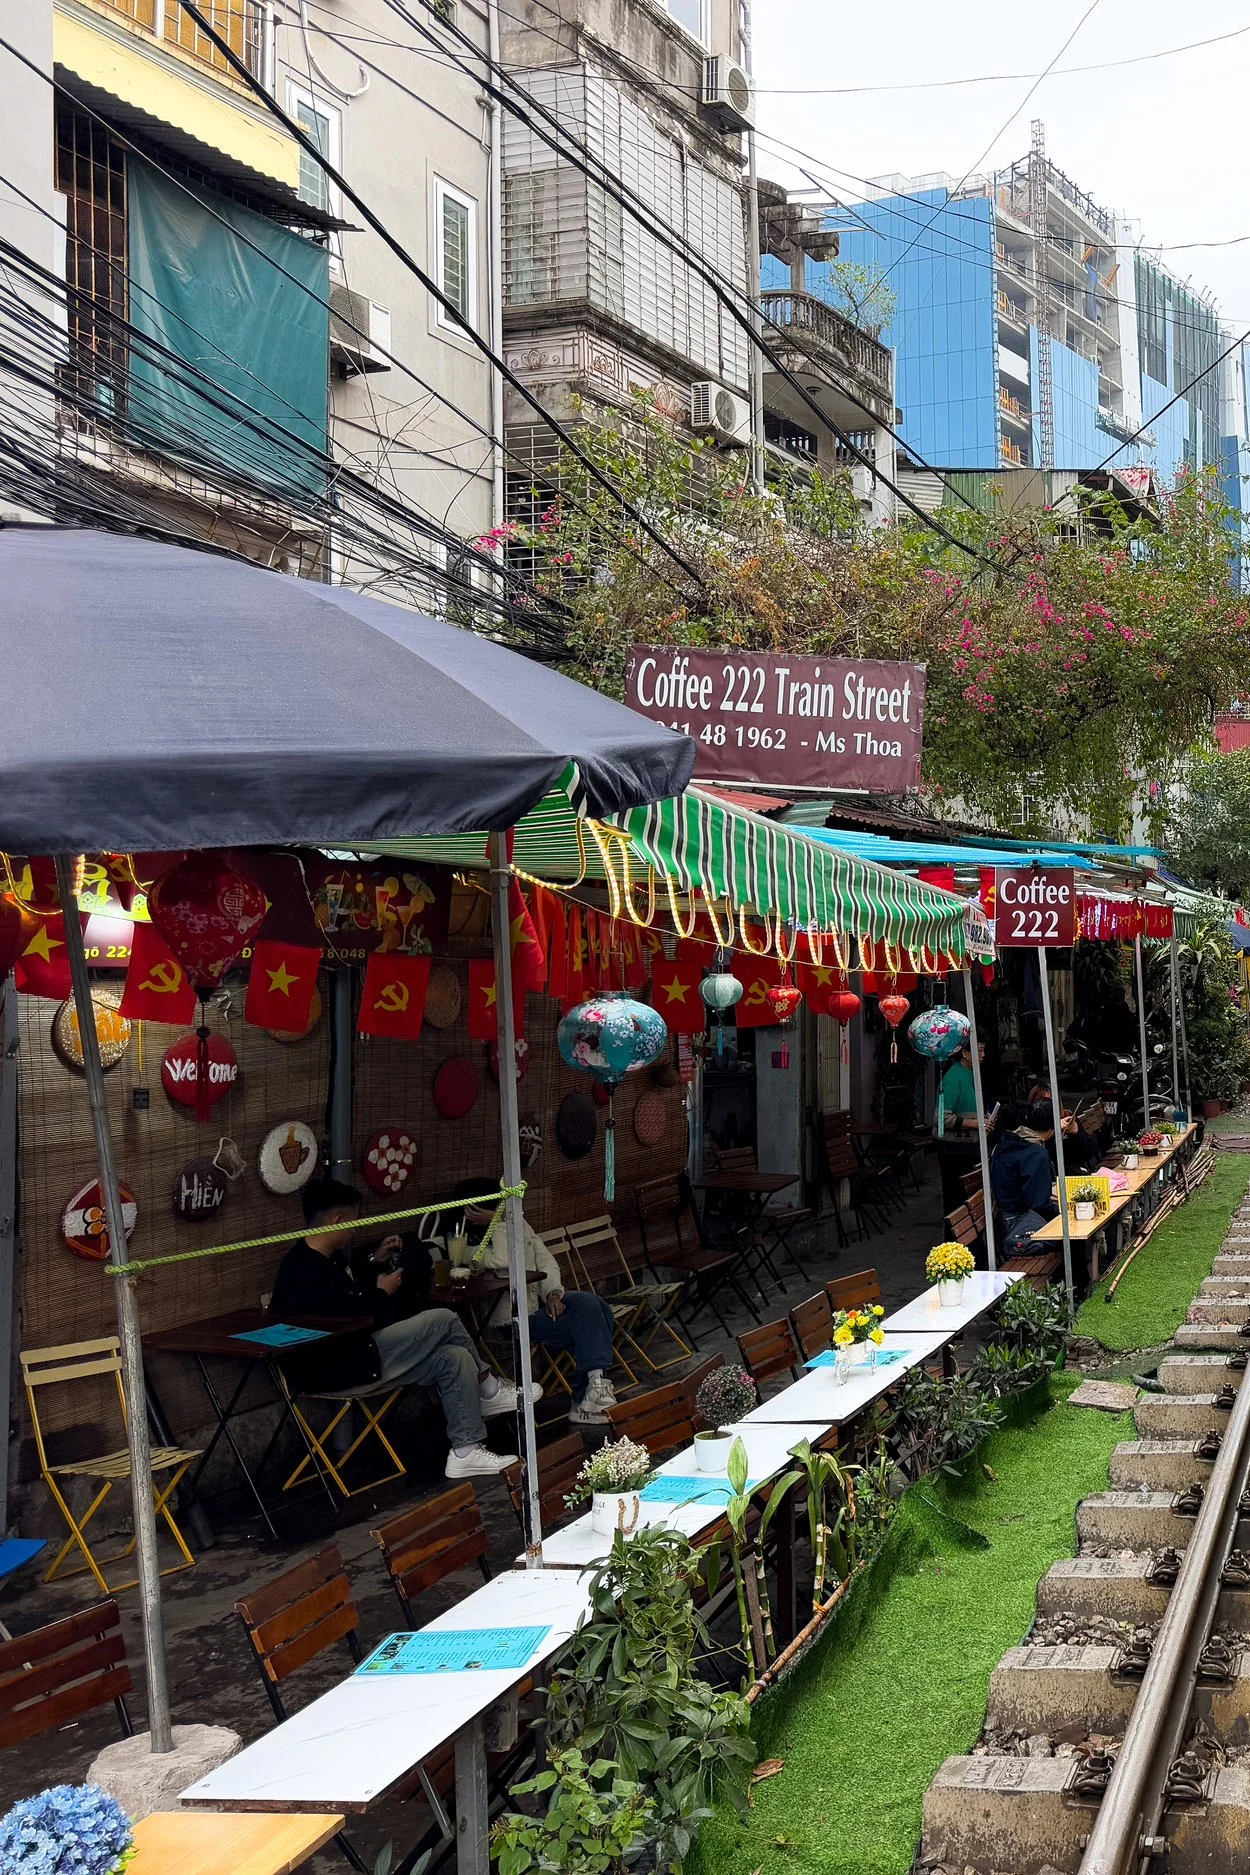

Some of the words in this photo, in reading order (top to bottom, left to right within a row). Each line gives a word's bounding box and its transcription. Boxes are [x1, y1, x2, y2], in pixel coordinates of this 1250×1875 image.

[636, 656, 714, 711] Coffee
[719, 665, 767, 713] 222
[774, 666, 836, 718] Train
[841, 671, 911, 723] Street
[699, 723, 727, 746] 48
[734, 725, 787, 750] 1962
[815, 730, 846, 754] Ms
[852, 732, 903, 758] Thoa
[1000, 876, 1070, 905] Coffee
[1011, 910, 1059, 938] 222
[164, 1057, 238, 1084] Weome
